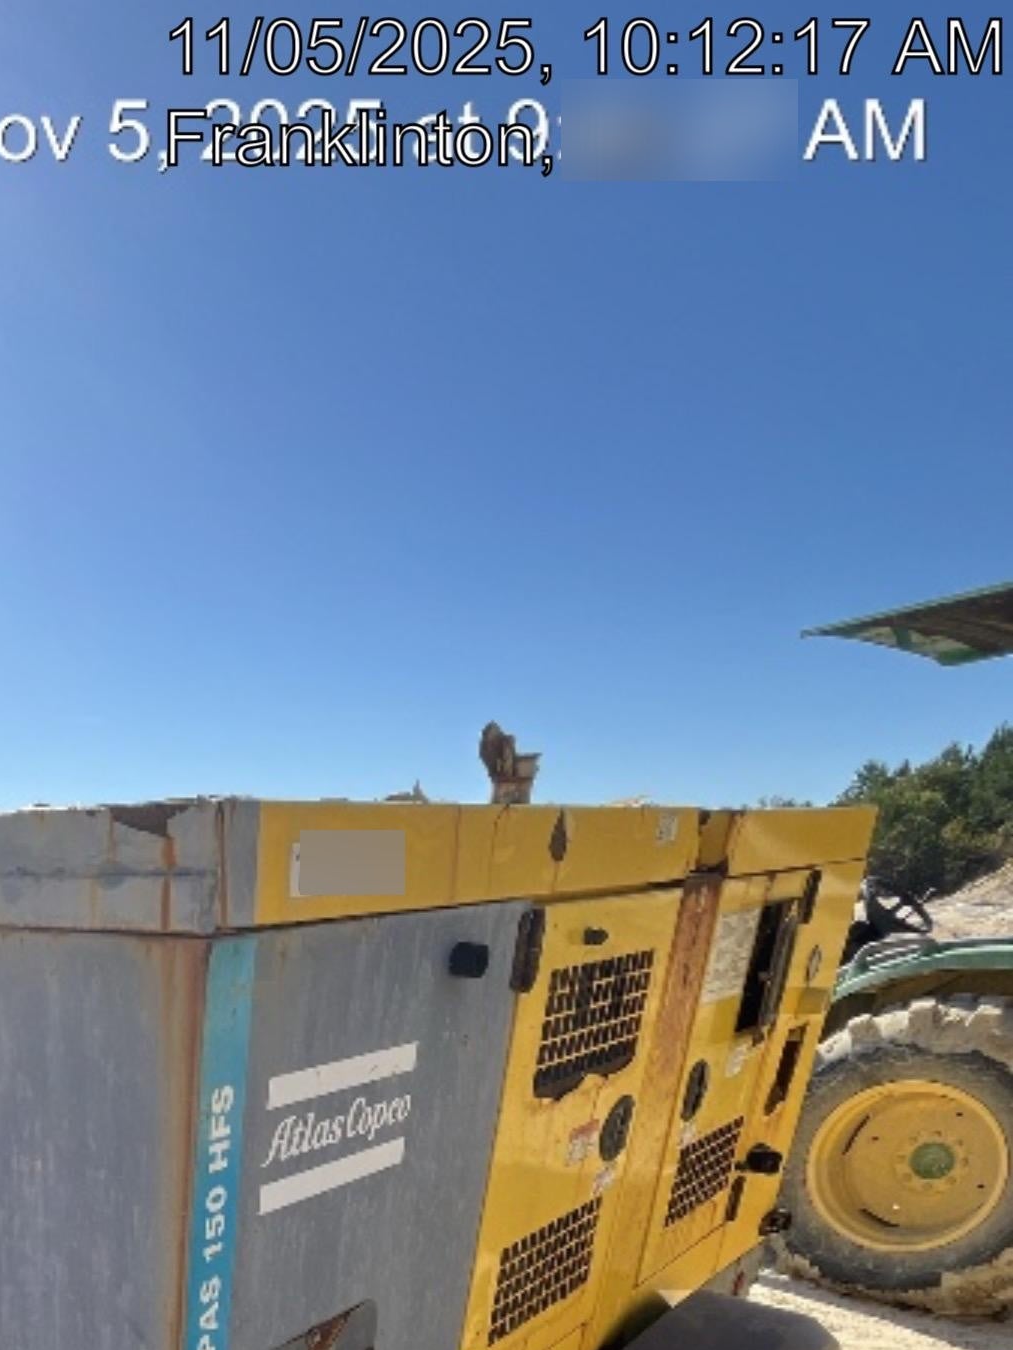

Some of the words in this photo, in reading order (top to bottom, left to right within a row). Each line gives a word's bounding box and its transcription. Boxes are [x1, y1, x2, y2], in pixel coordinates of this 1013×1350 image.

[208, 1084, 235, 1174] HFS
[261, 1112, 345, 1168] Atlas
[347, 1094, 412, 1140] Copco
[203, 1186, 228, 1263] 150
